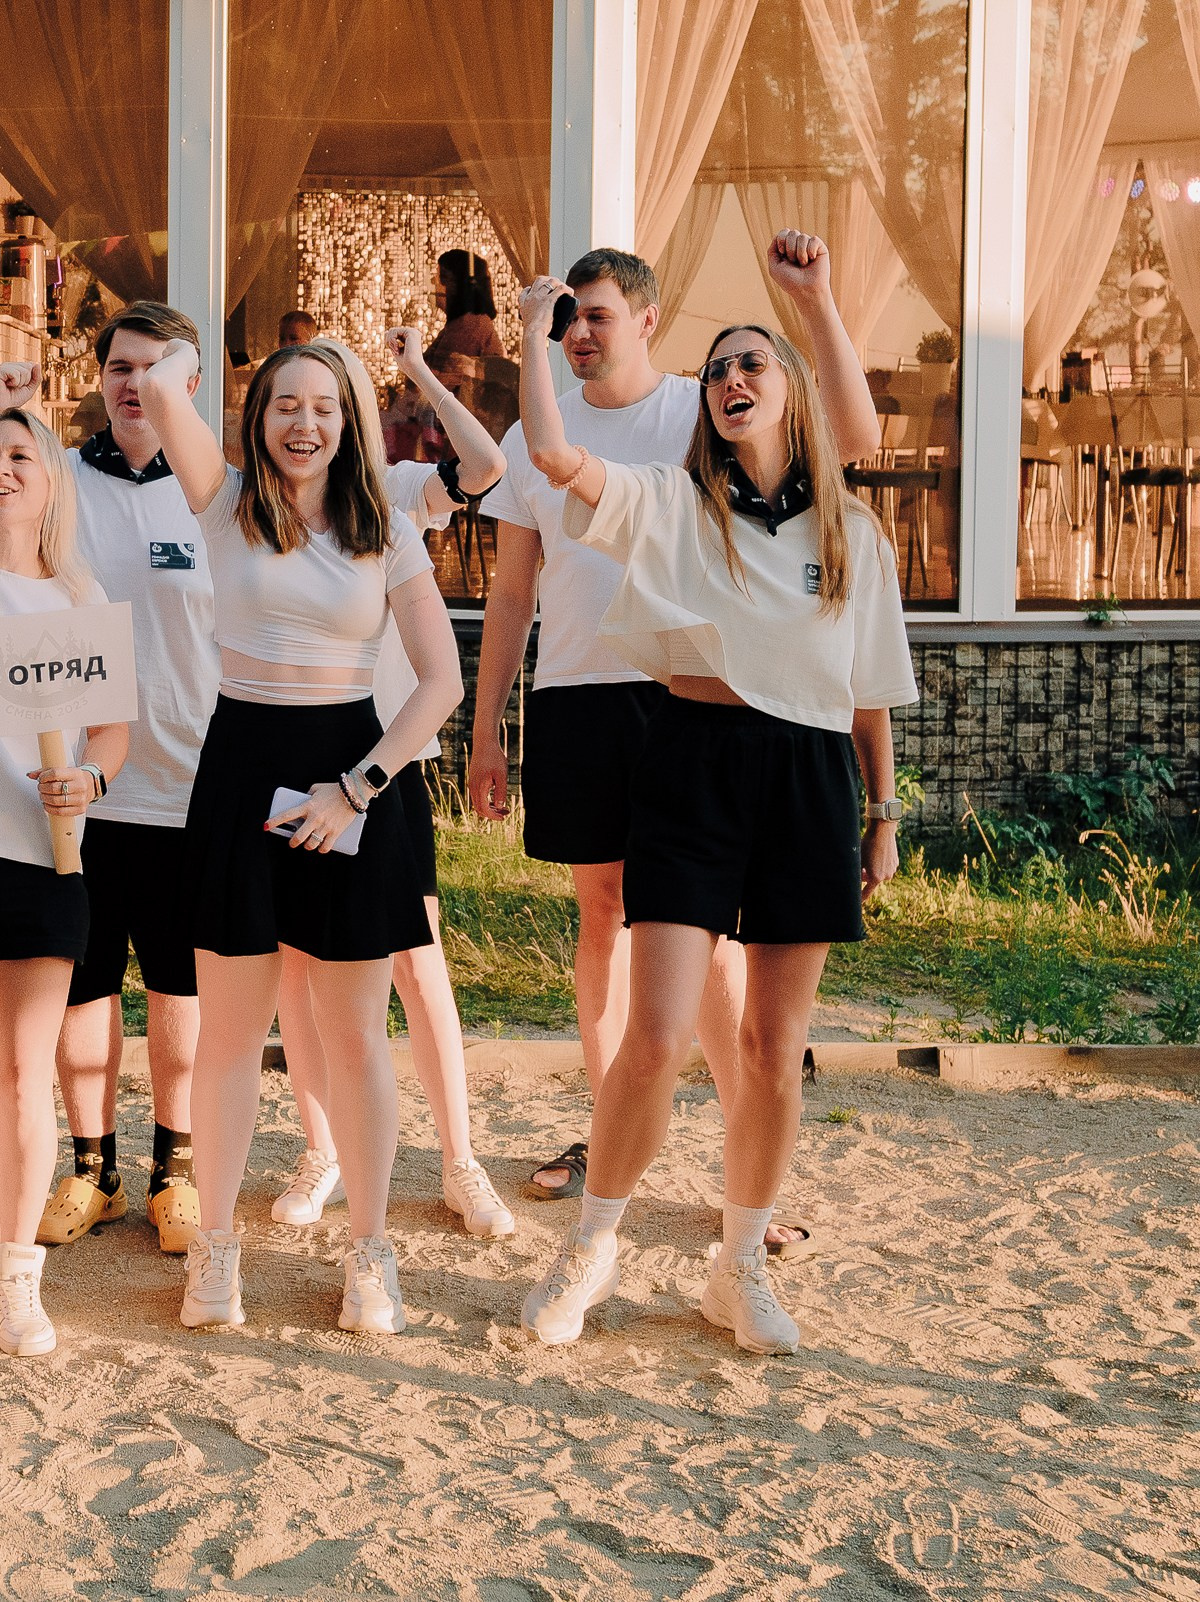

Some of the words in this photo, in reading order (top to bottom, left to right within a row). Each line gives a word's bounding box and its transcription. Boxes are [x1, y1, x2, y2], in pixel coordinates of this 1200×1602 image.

[8, 655, 107, 685] ОТРЯД
[5, 704, 53, 720] СМЕНА
[57, 696, 89, 717] 2023
